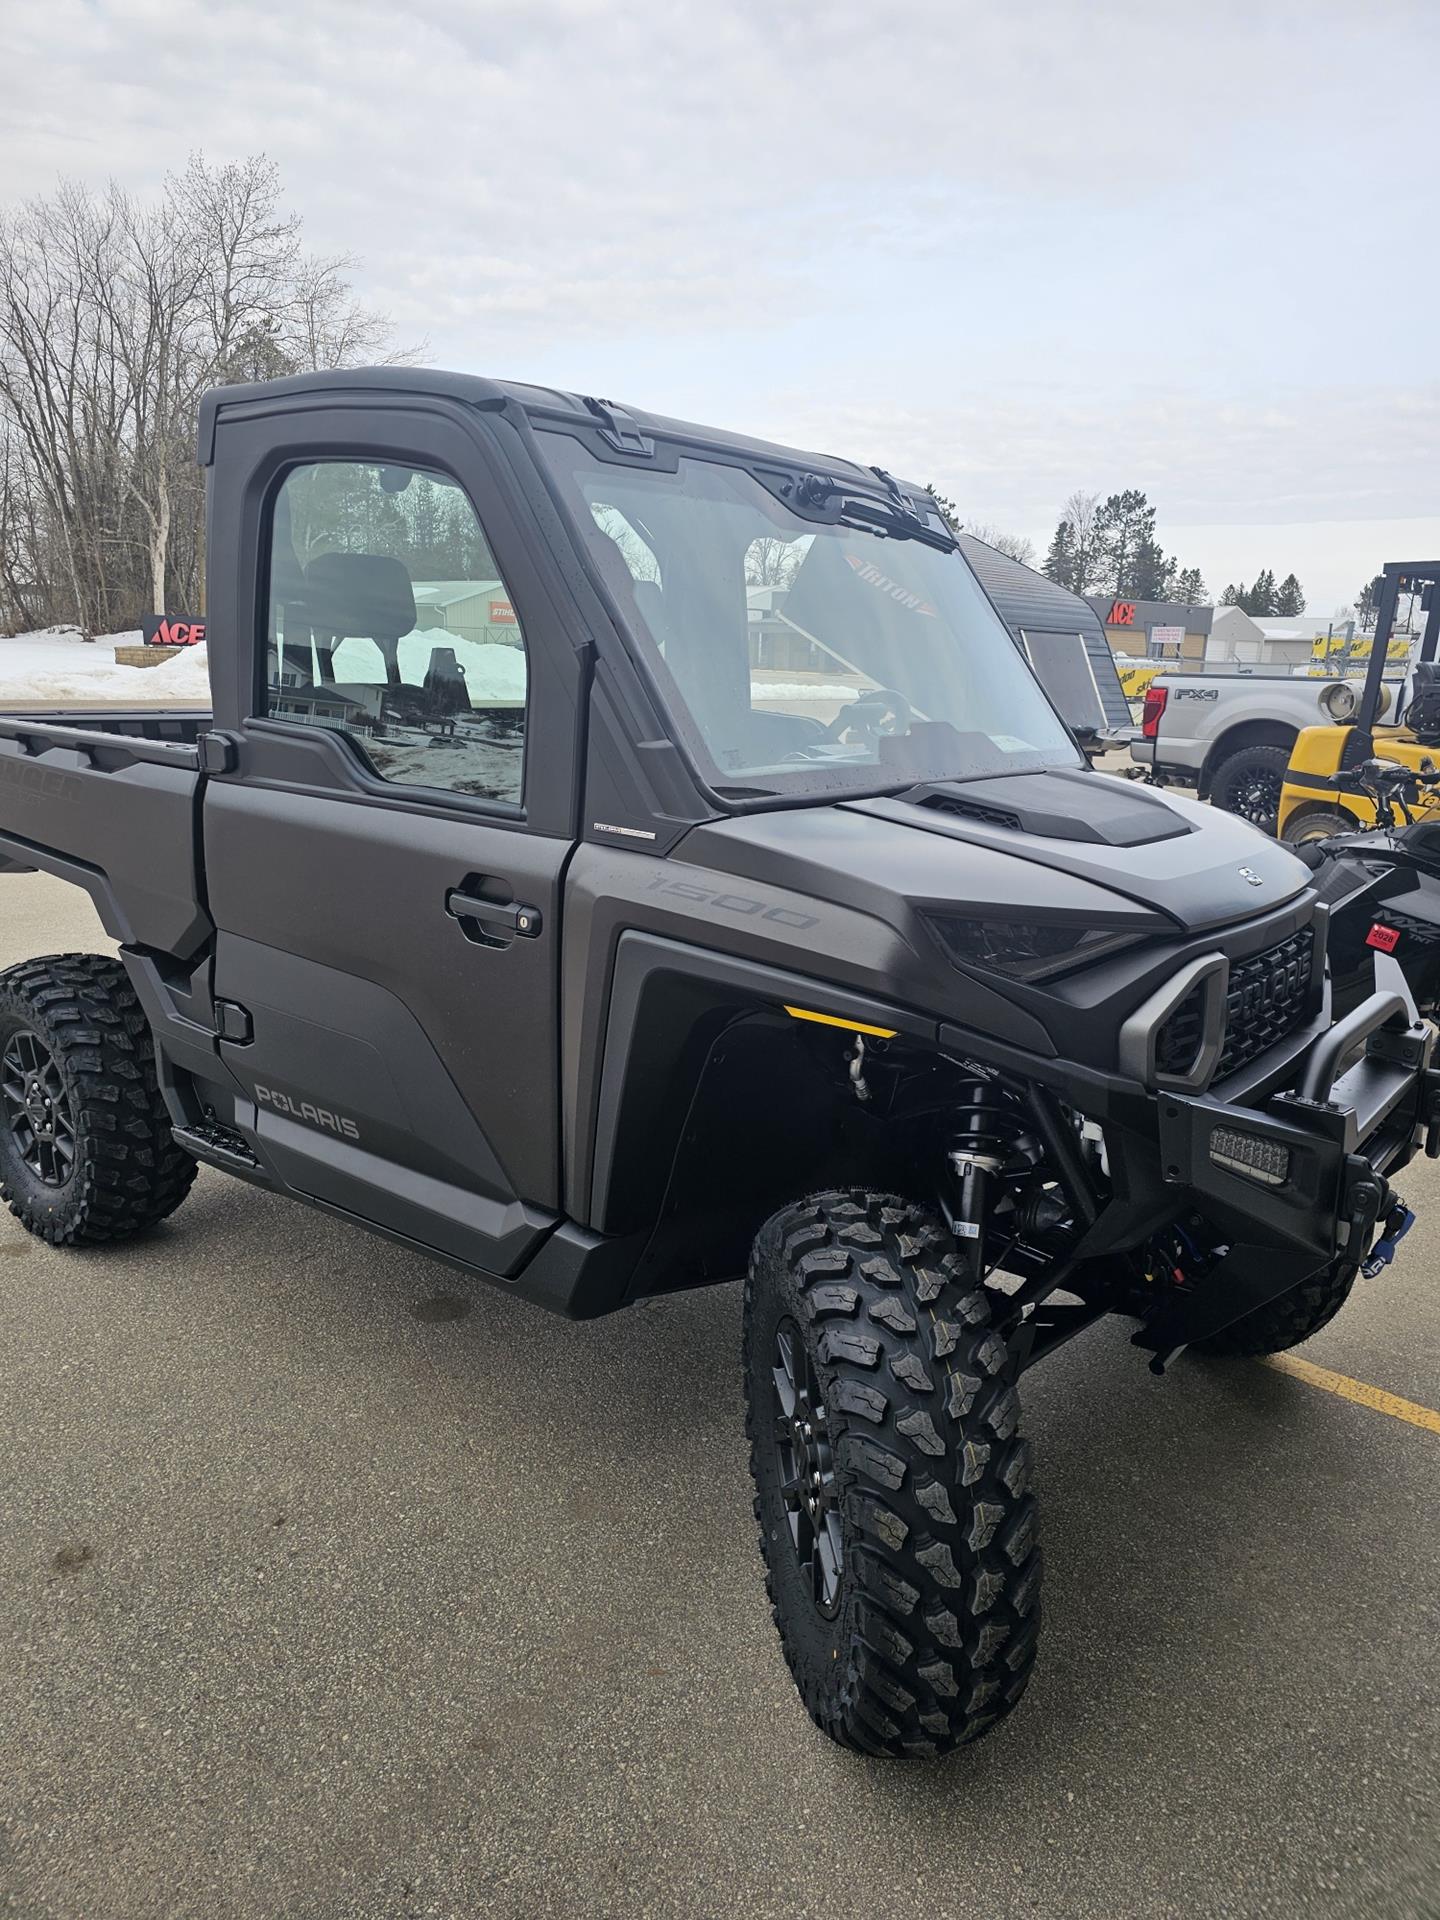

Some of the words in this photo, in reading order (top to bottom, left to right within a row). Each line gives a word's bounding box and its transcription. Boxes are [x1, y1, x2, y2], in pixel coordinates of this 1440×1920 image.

[858, 560, 921, 609] TRITON
[492, 607, 515, 616] STIHL
[1106, 600, 1137, 625] ACE
[151, 619, 206, 644] ACE
[1174, 688, 1219, 701] FX4
[648, 877, 821, 930] 1500
[254, 1083, 360, 1140] POLARIS
